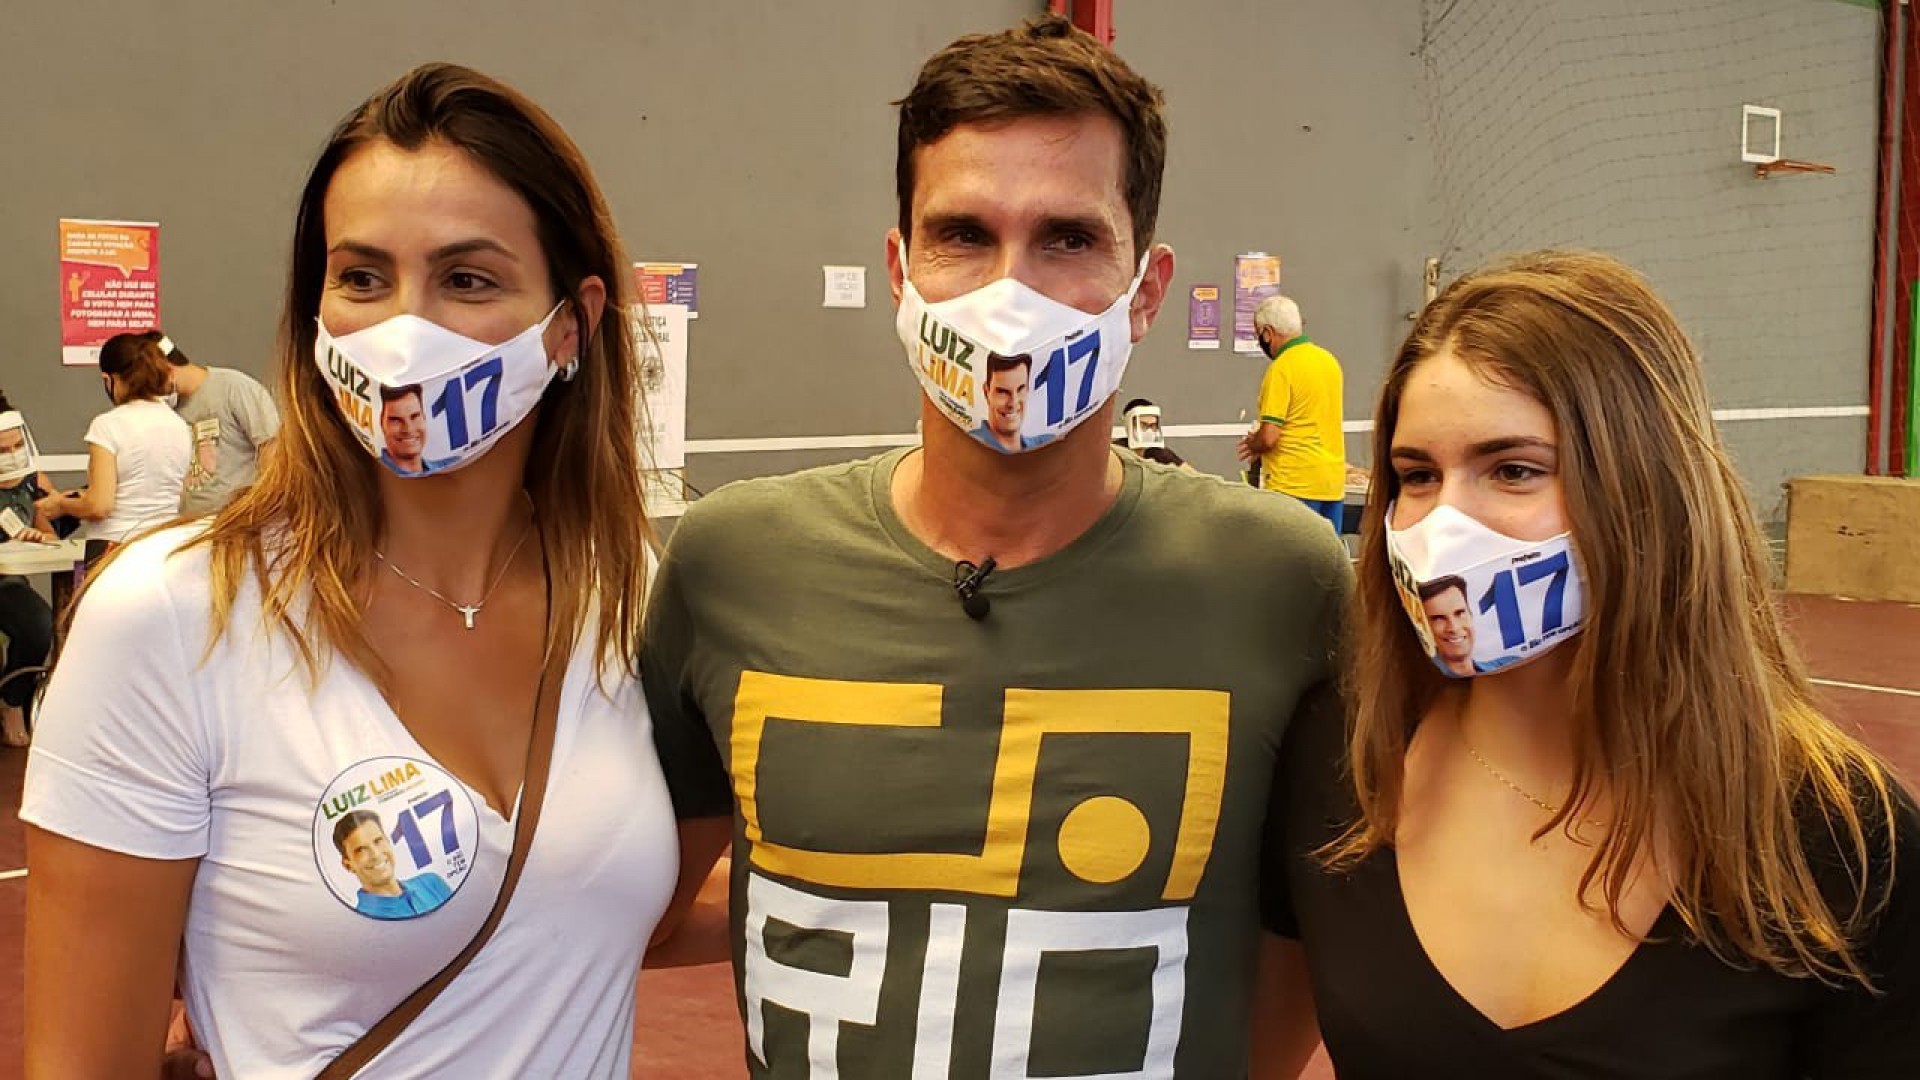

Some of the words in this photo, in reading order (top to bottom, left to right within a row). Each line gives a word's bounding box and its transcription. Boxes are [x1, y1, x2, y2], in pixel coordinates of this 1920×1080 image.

[82, 290, 117, 298] CELULAR
[118, 290, 155, 299] DURANTE
[84, 300, 91, 308] O
[116, 300, 133, 308] NEM
[134, 300, 155, 309] PARA
[105, 279, 122, 289] NÃO
[123, 281, 139, 289] USE
[70, 309, 123, 318] FOTOGRAFAR
[87, 319, 105, 328] NEM
[106, 320, 127, 328] PARA
[920, 312, 974, 372] LUIZ
[328, 347, 370, 402] LUIZ
[431, 356, 504, 450] 17
[1034, 329, 1100, 427] 17
[1478, 550, 1569, 651] 17
[322, 784, 371, 819] LUIZ
[368, 762, 421, 796] LIMA
[391, 789, 459, 870] 17
[744, 871, 1190, 1080] RIO
